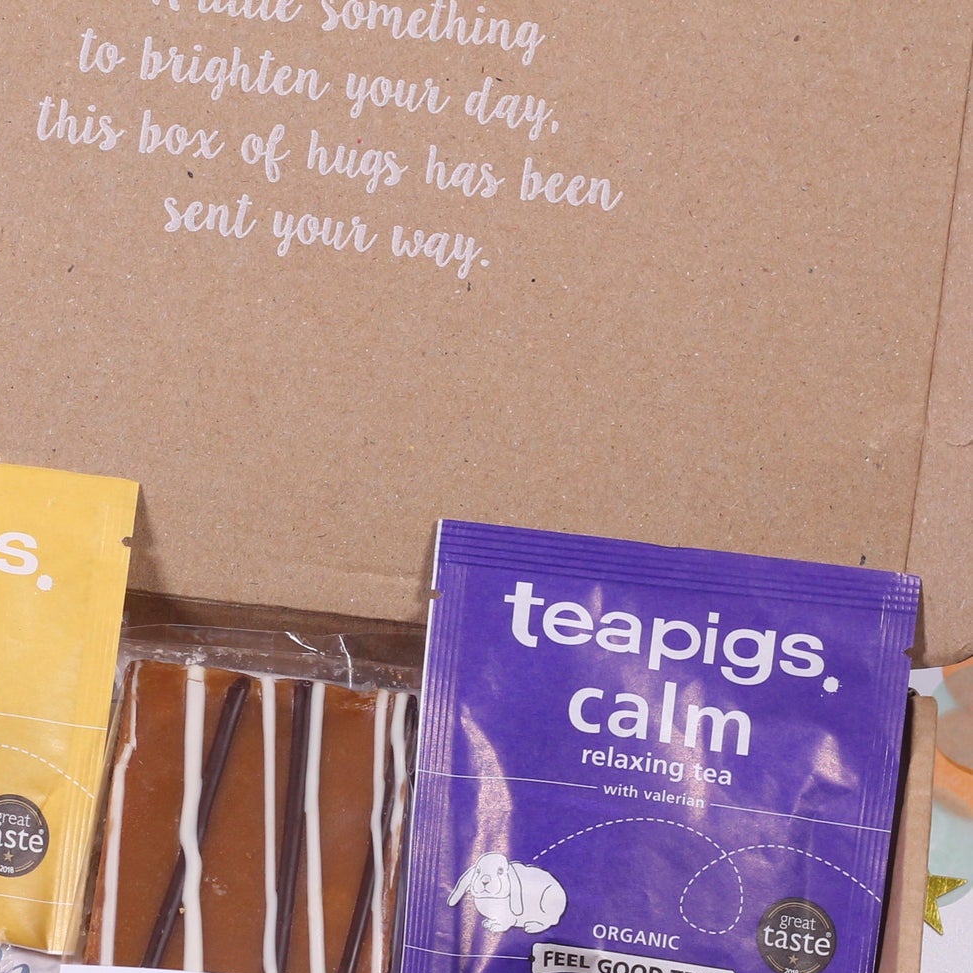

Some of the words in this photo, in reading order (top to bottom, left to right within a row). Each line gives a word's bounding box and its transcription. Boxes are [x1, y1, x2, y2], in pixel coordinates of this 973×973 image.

[320, 0, 545, 65] something
[79, 27, 125, 73] to
[139, 36, 330, 100] brighten
[345, 72, 450, 118] your
[464, 76, 559, 140] day,
[36, 96, 125, 150] this
[138, 109, 225, 159] box
[239, 124, 289, 183] of
[306, 130, 408, 194] hugs
[425, 144, 505, 198] has
[519, 157, 624, 211] been
[164, 194, 257, 238] sent
[272, 211, 378, 257] your
[390, 224, 490, 279] way.
[568, 681, 752, 757] calm
[582, 747, 685, 782] relaxing
[693, 762, 733, 786] tea
[603, 783, 638, 799] with
[643, 787, 705, 809] valerian
[592, 924, 680, 951] ORGANIC
[779, 915, 816, 931] great
[543, 950, 591, 969] FEEL
